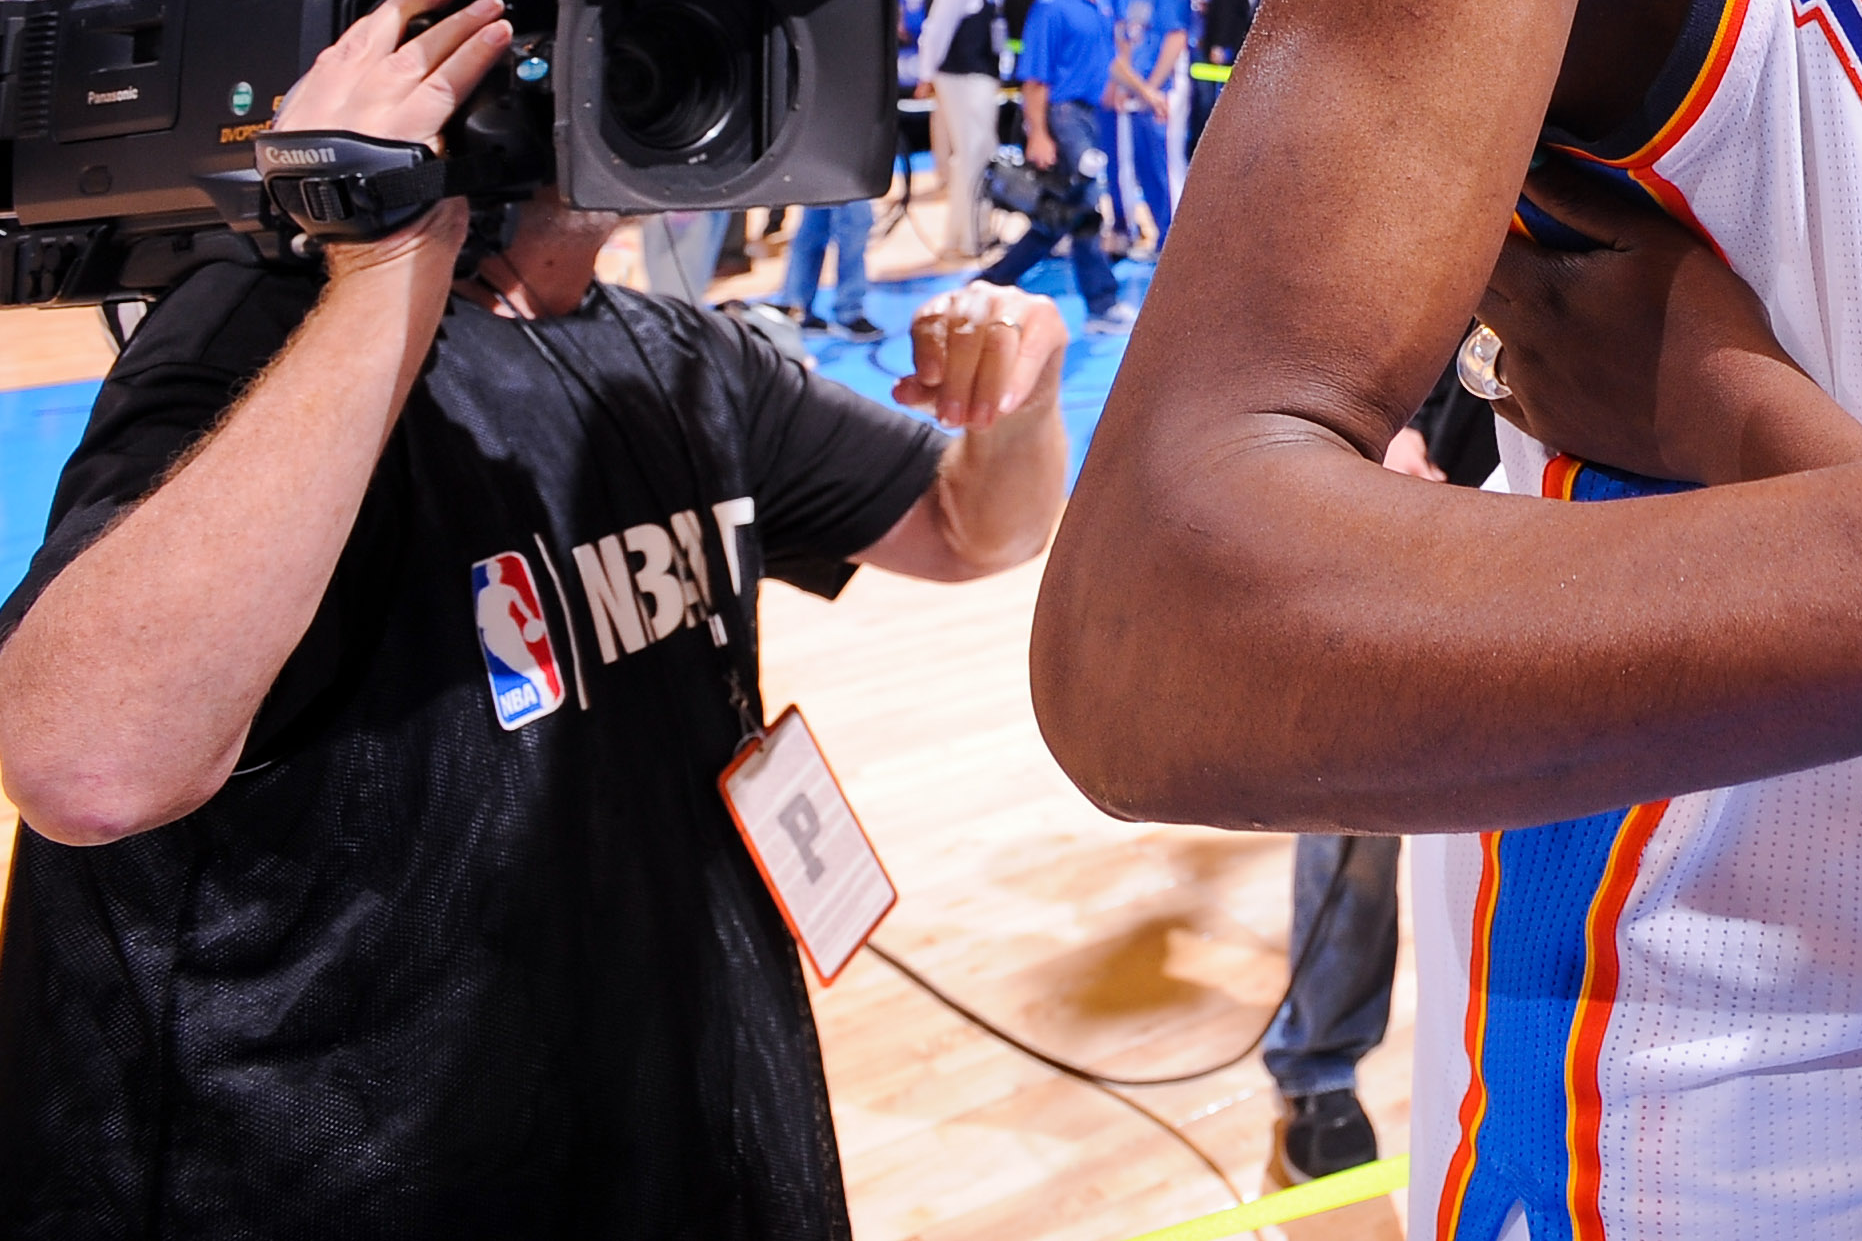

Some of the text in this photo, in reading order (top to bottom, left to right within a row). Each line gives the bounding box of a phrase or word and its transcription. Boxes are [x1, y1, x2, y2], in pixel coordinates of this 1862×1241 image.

[88, 85, 139, 105] Panasonic
[266, 146, 336, 165] Canon
[499, 682, 539, 718] NBA
